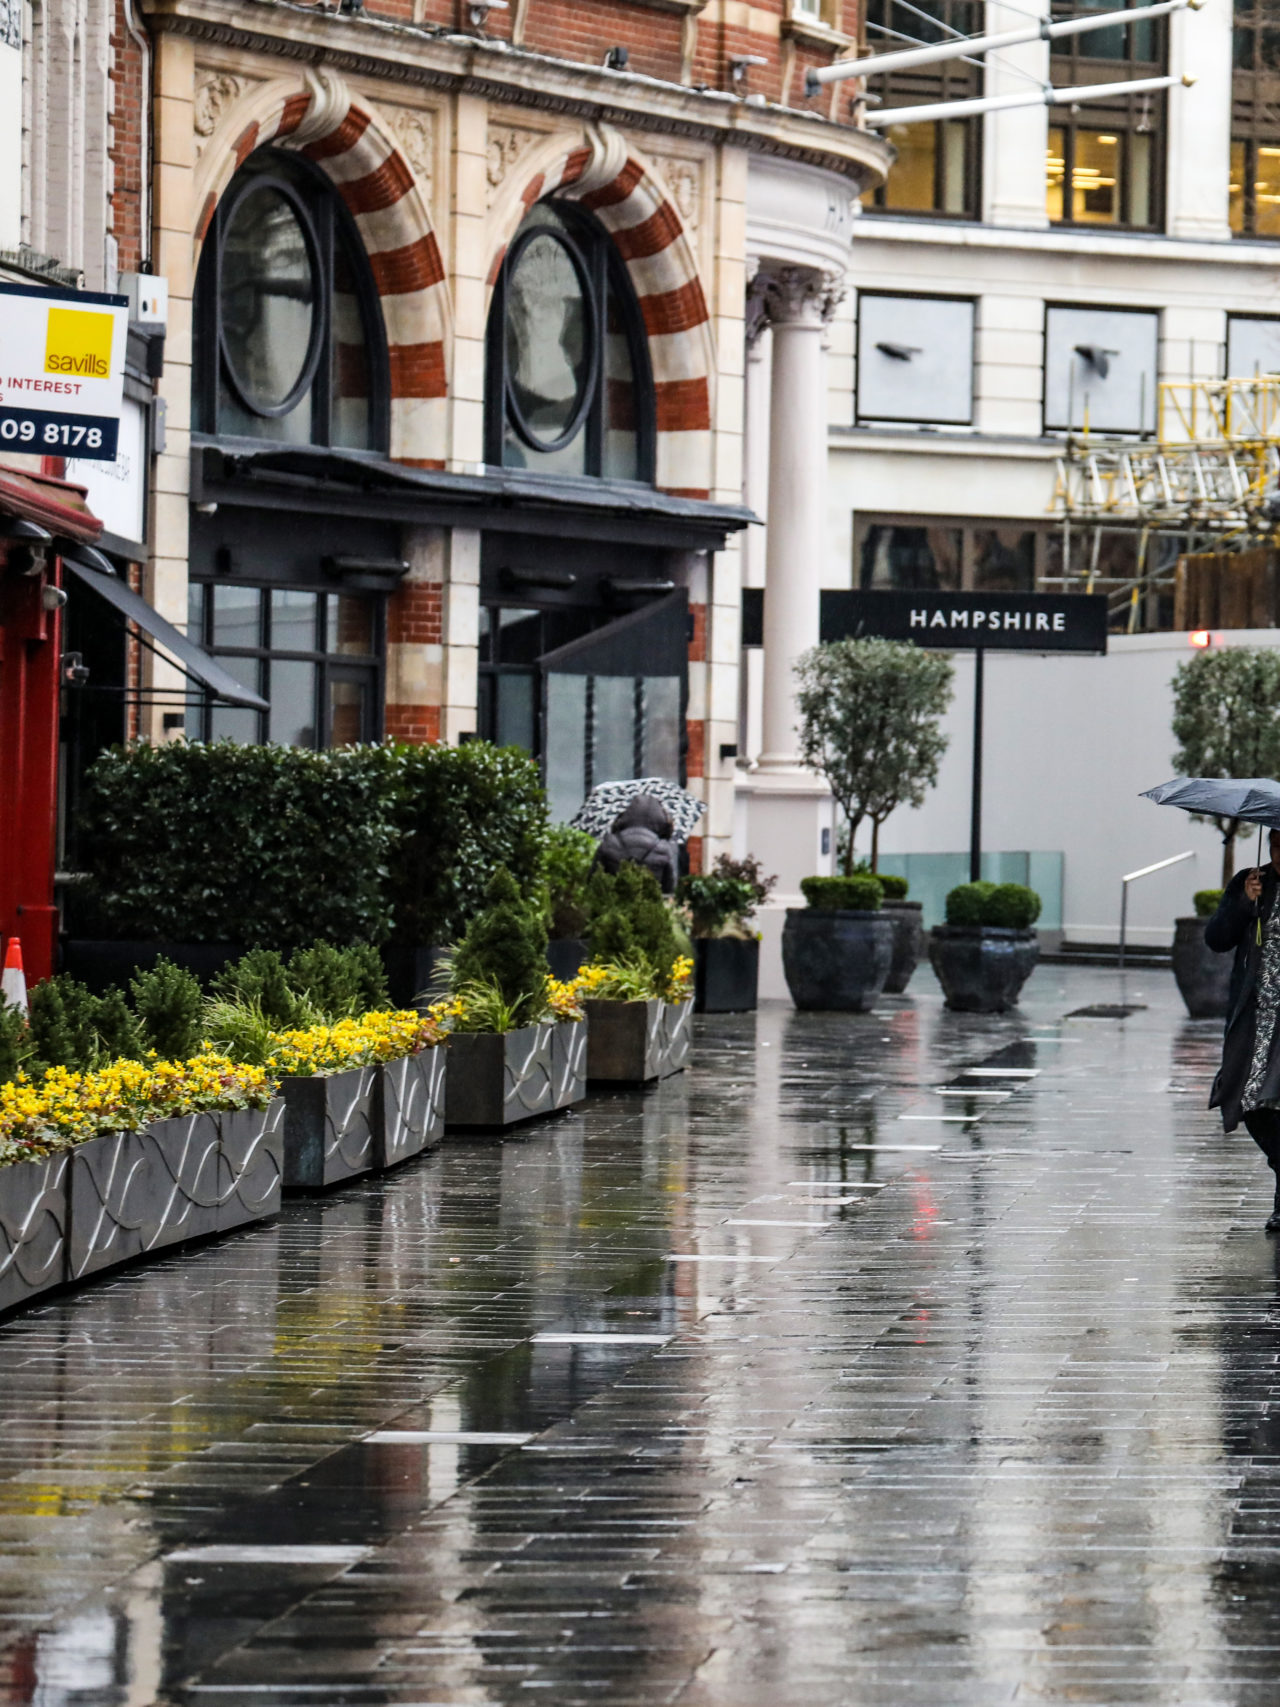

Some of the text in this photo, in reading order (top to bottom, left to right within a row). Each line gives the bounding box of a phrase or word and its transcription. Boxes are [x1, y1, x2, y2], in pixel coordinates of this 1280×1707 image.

[47, 354, 107, 375] savills
[8, 377, 82, 395] INTEREST
[1, 419, 102, 447] 09 8178
[910, 609, 1066, 631] HAMPSHIRE
